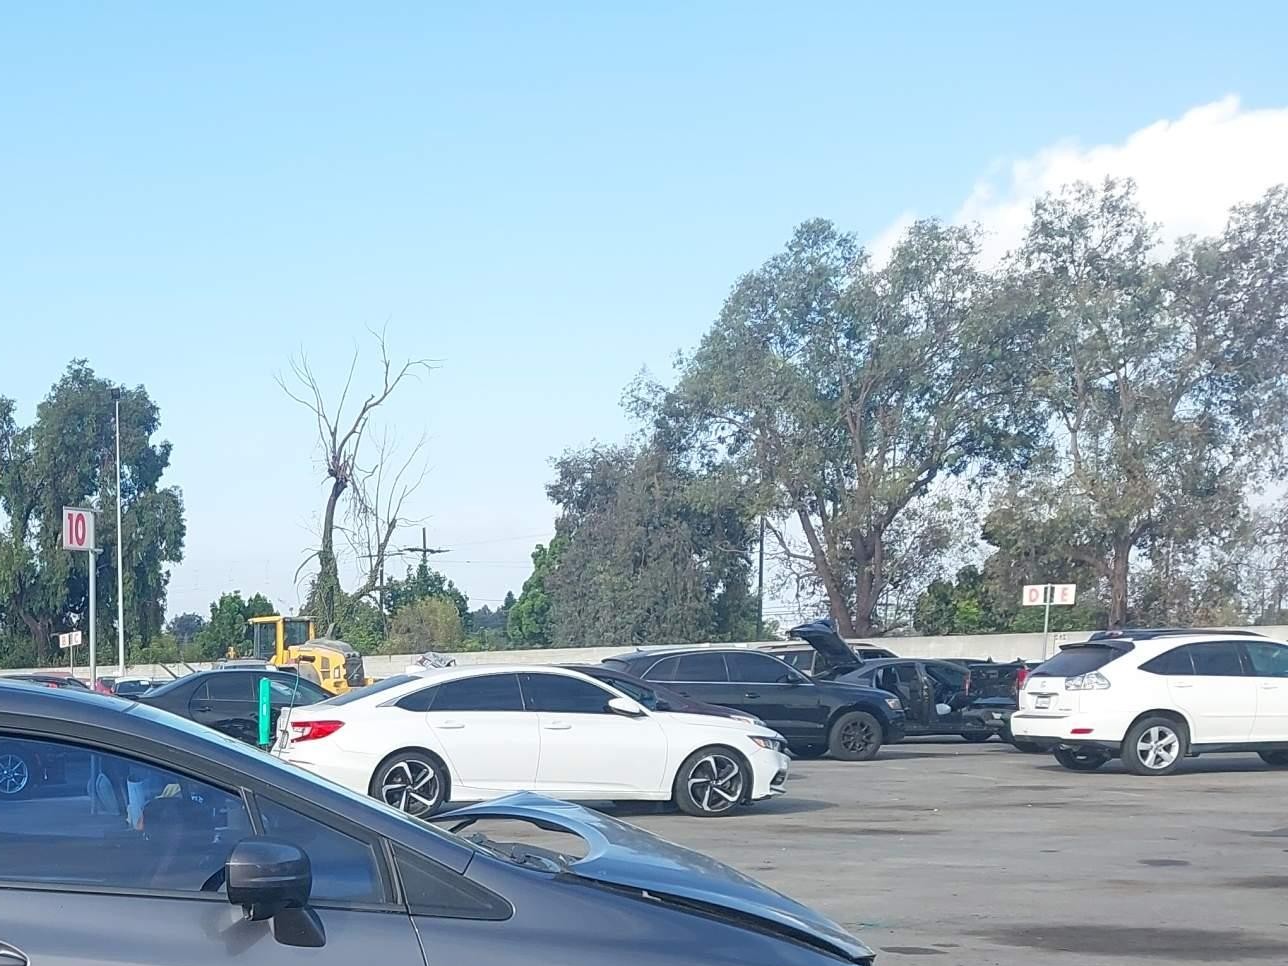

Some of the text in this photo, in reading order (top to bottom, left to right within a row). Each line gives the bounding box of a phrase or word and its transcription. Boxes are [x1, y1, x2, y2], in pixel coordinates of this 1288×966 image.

[67, 512, 86, 546] 10
[1028, 586, 1070, 603] D E
